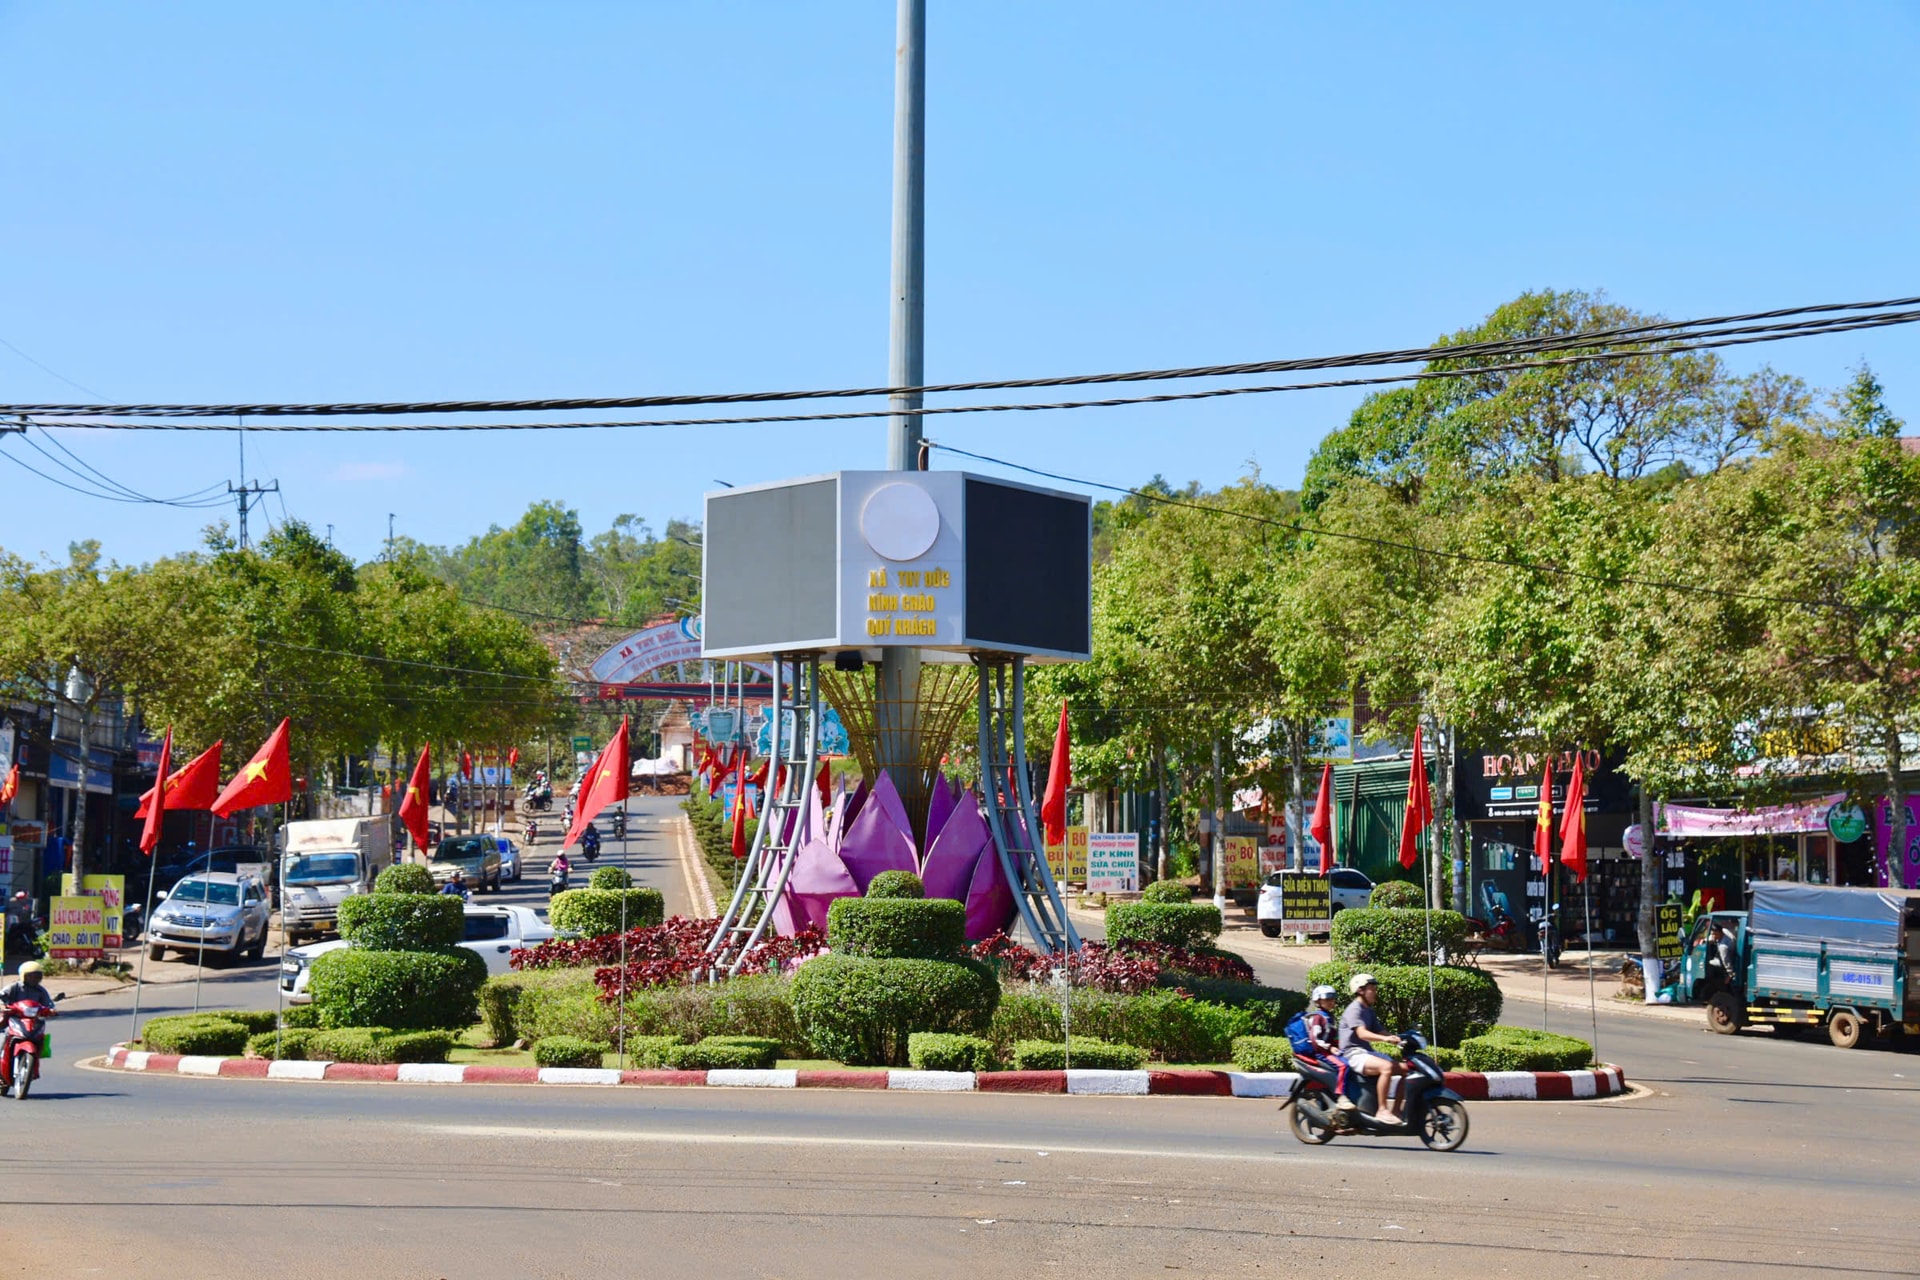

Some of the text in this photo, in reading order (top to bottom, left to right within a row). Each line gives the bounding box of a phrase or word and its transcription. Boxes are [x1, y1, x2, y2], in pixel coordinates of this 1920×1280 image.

[897, 571, 921, 588] TUY
[868, 592, 935, 612] KÍNH CHÀO
[866, 614, 936, 637] QUÝ KHÁCH
[1092, 850, 1106, 858] ÉP
[1109, 850, 1134, 858] KÍNH
[1090, 859, 1136, 868] SỬA CHỮA
